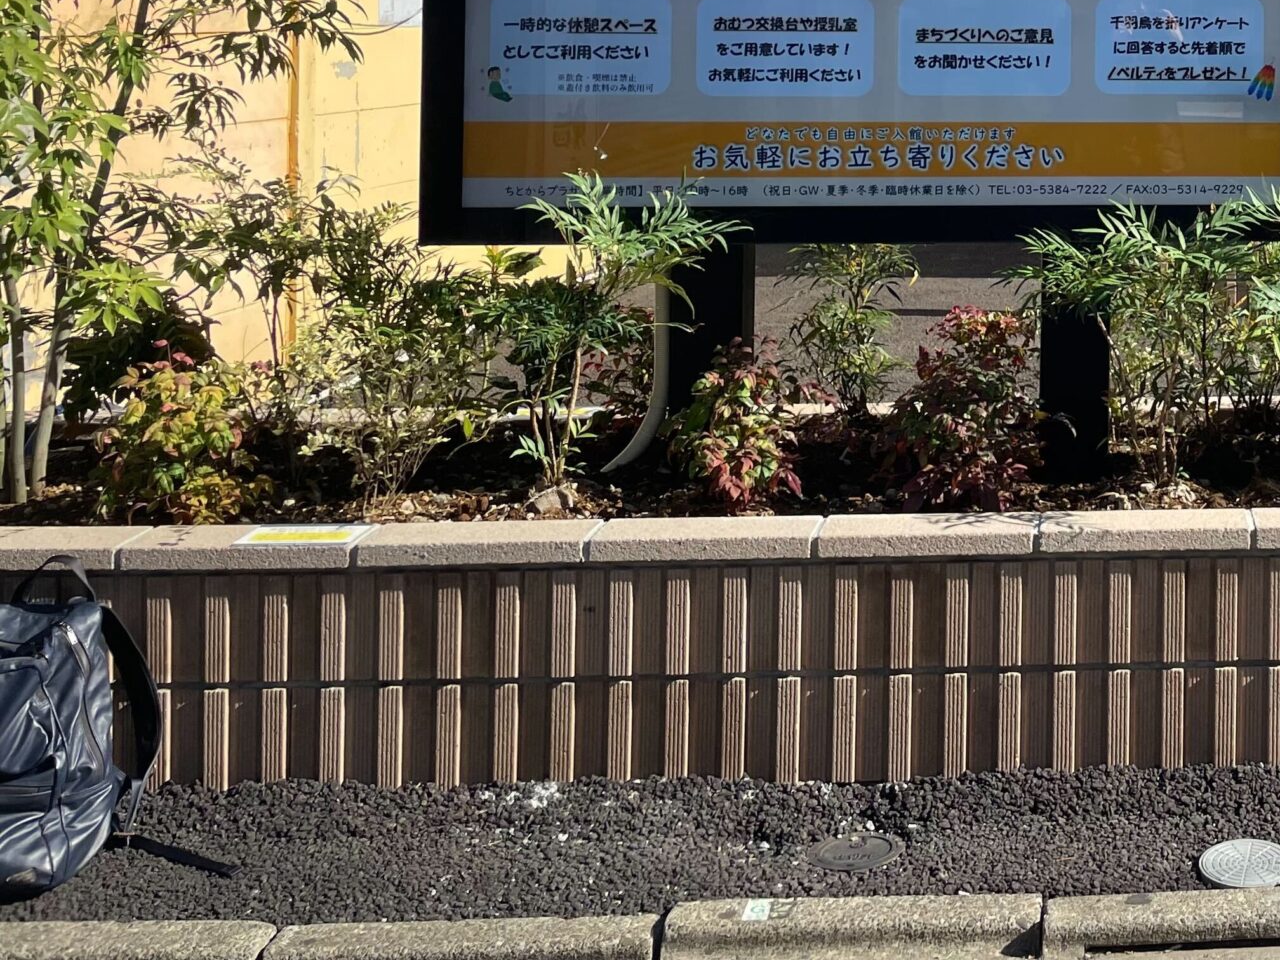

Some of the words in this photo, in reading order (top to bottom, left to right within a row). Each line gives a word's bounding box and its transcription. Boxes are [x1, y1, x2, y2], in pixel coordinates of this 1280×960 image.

[503, 16, 658, 35] 一時的な休憩スペース
[713, 16, 858, 32] おむつ交換台や授乳室
[915, 27, 1054, 45] まちづくりへのご意見
[503, 43, 650, 61] としてご利用ください
[716, 42, 850, 57] をご用意しています！
[1113, 41, 1246, 55] に回答すると先着順で
[914, 54, 1052, 71] をお聞かせください！
[708, 68, 861, 83] お気軽にご利用ください
[1107, 66, 1250, 81] ノベルティをプレゼント！
[745, 126, 1017, 141] どなたでも自由にご入館いただけます
[693, 142, 1065, 171] お気軽にお立ち寄りください
[988, 184, 1108, 196] TEL:03-5384-7222
